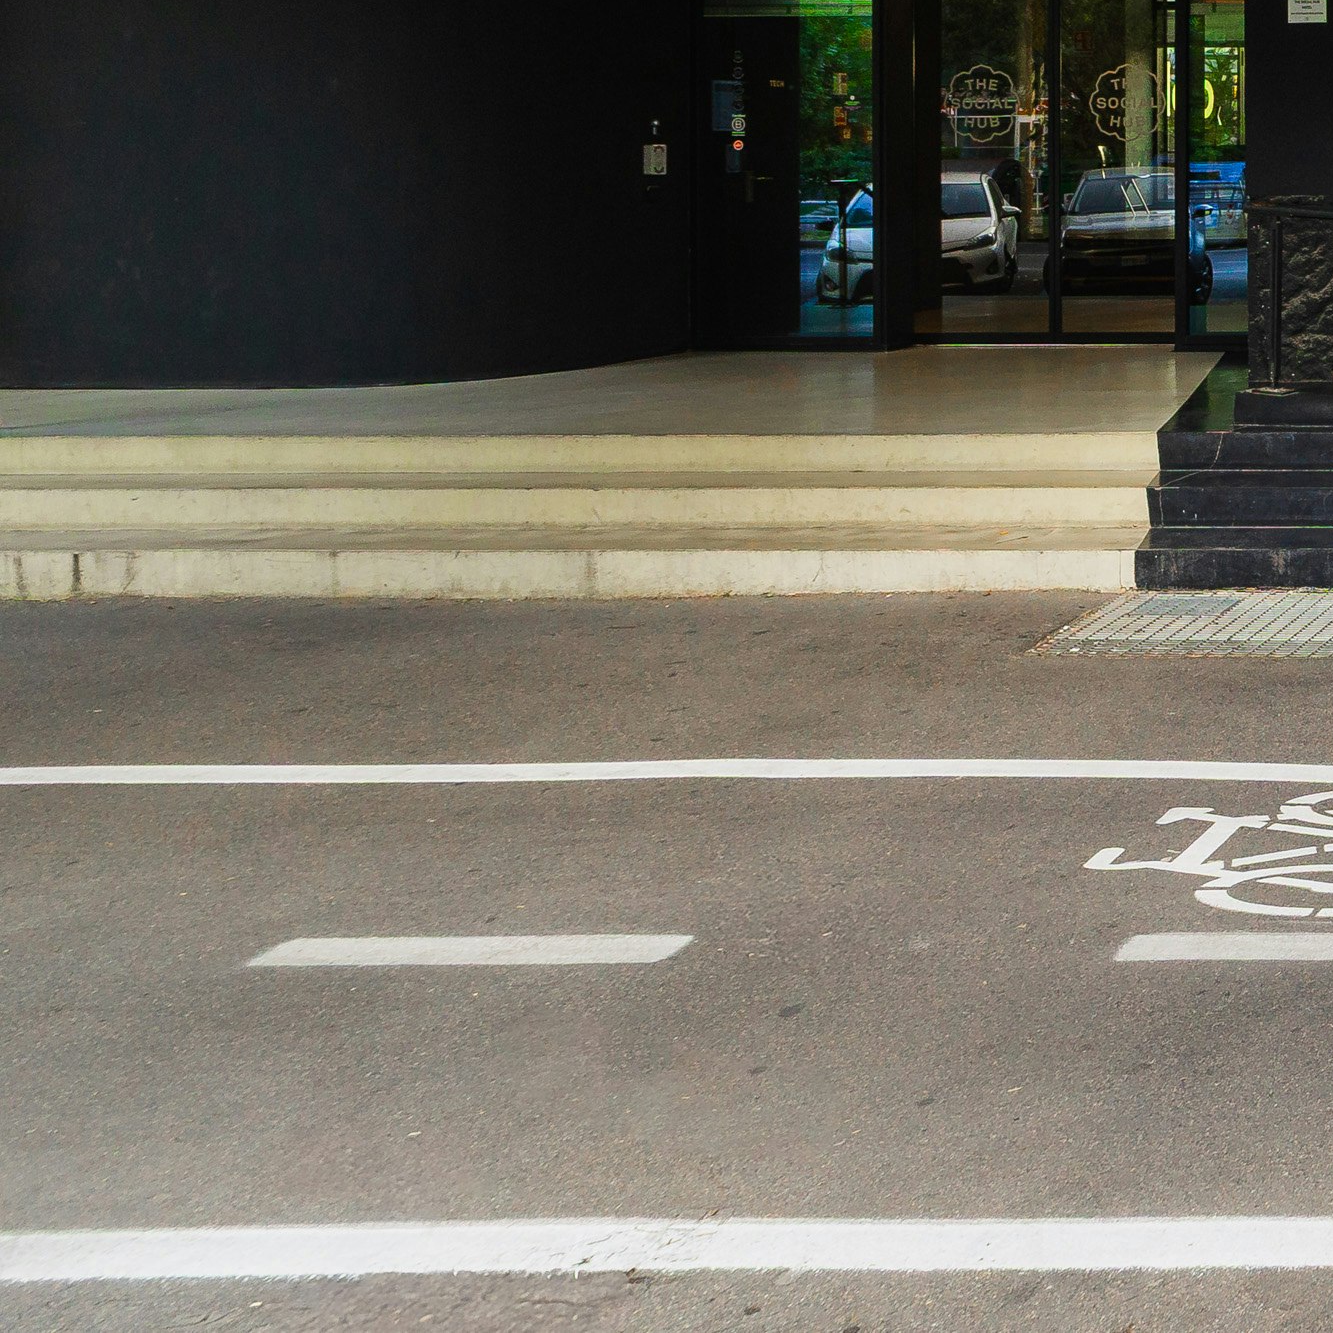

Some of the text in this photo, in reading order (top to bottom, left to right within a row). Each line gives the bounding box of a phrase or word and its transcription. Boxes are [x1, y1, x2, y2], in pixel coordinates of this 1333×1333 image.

[964, 78, 999, 91] THE
[951, 97, 1014, 110] SOCIAL
[964, 116, 1001, 129] HUB
